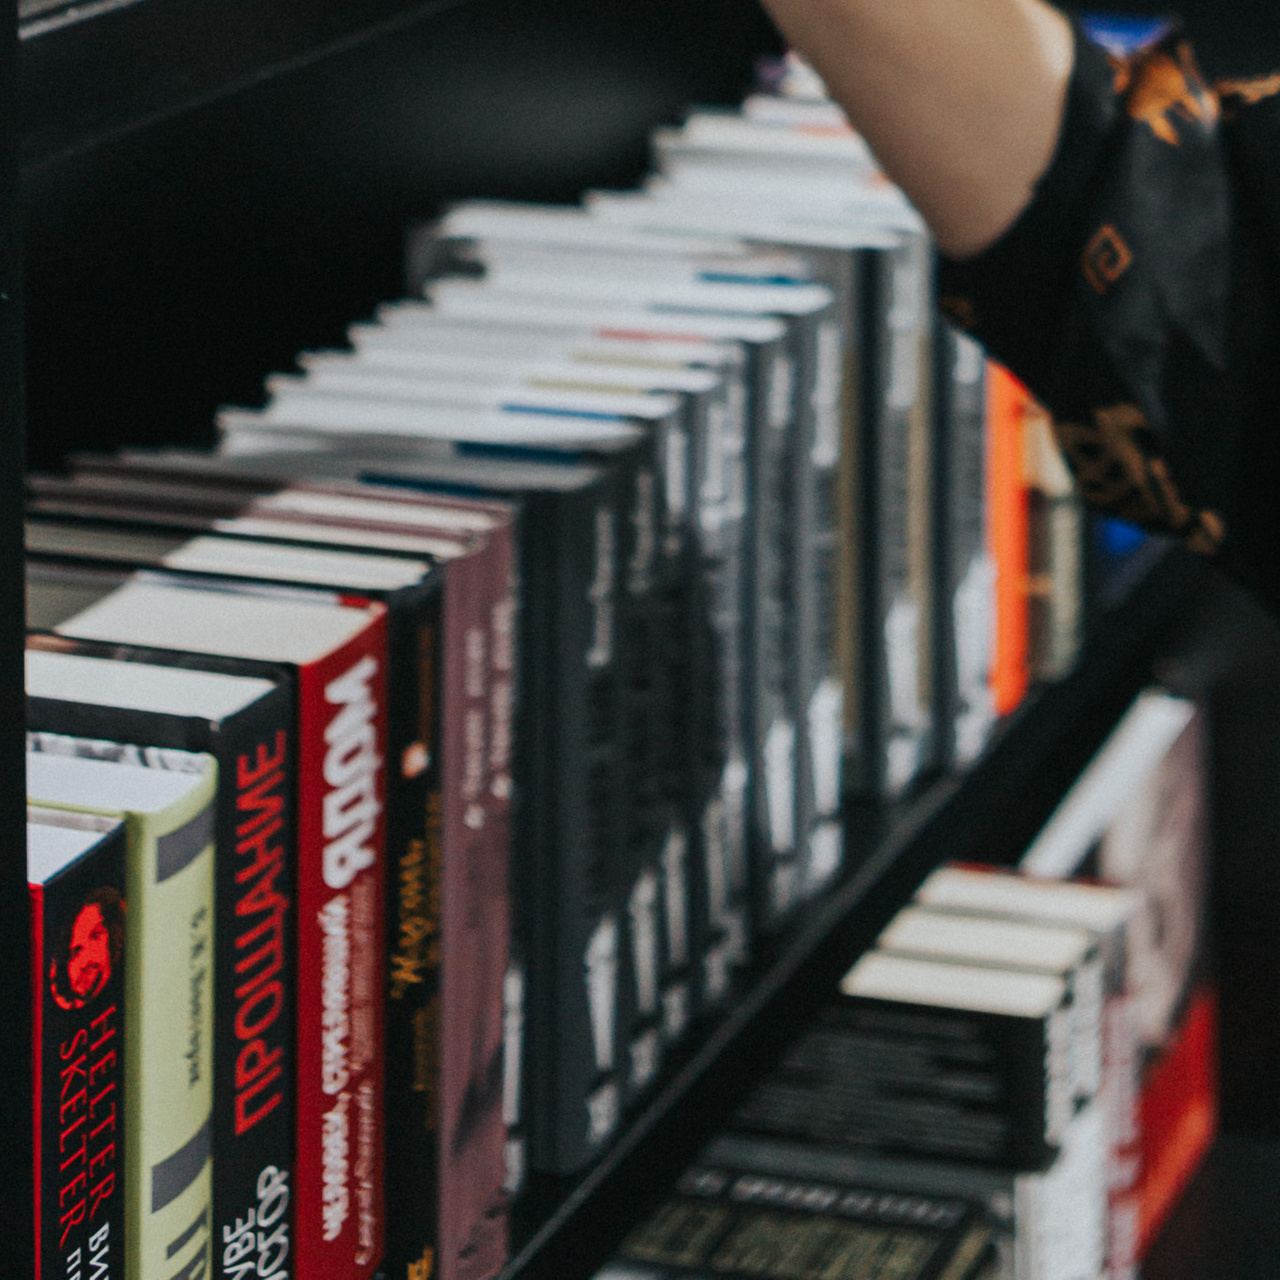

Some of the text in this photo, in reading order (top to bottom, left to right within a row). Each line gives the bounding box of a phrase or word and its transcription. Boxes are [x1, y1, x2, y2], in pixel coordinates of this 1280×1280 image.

[322, 654, 384, 889] ЯДОМ
[234, 729, 290, 1137] ПРОЩАНИЕ
[59, 1028, 88, 1252] SKELTER
[89, 1003, 118, 1224] HELTER
[88, 1222, 110, 1280] ВИ
